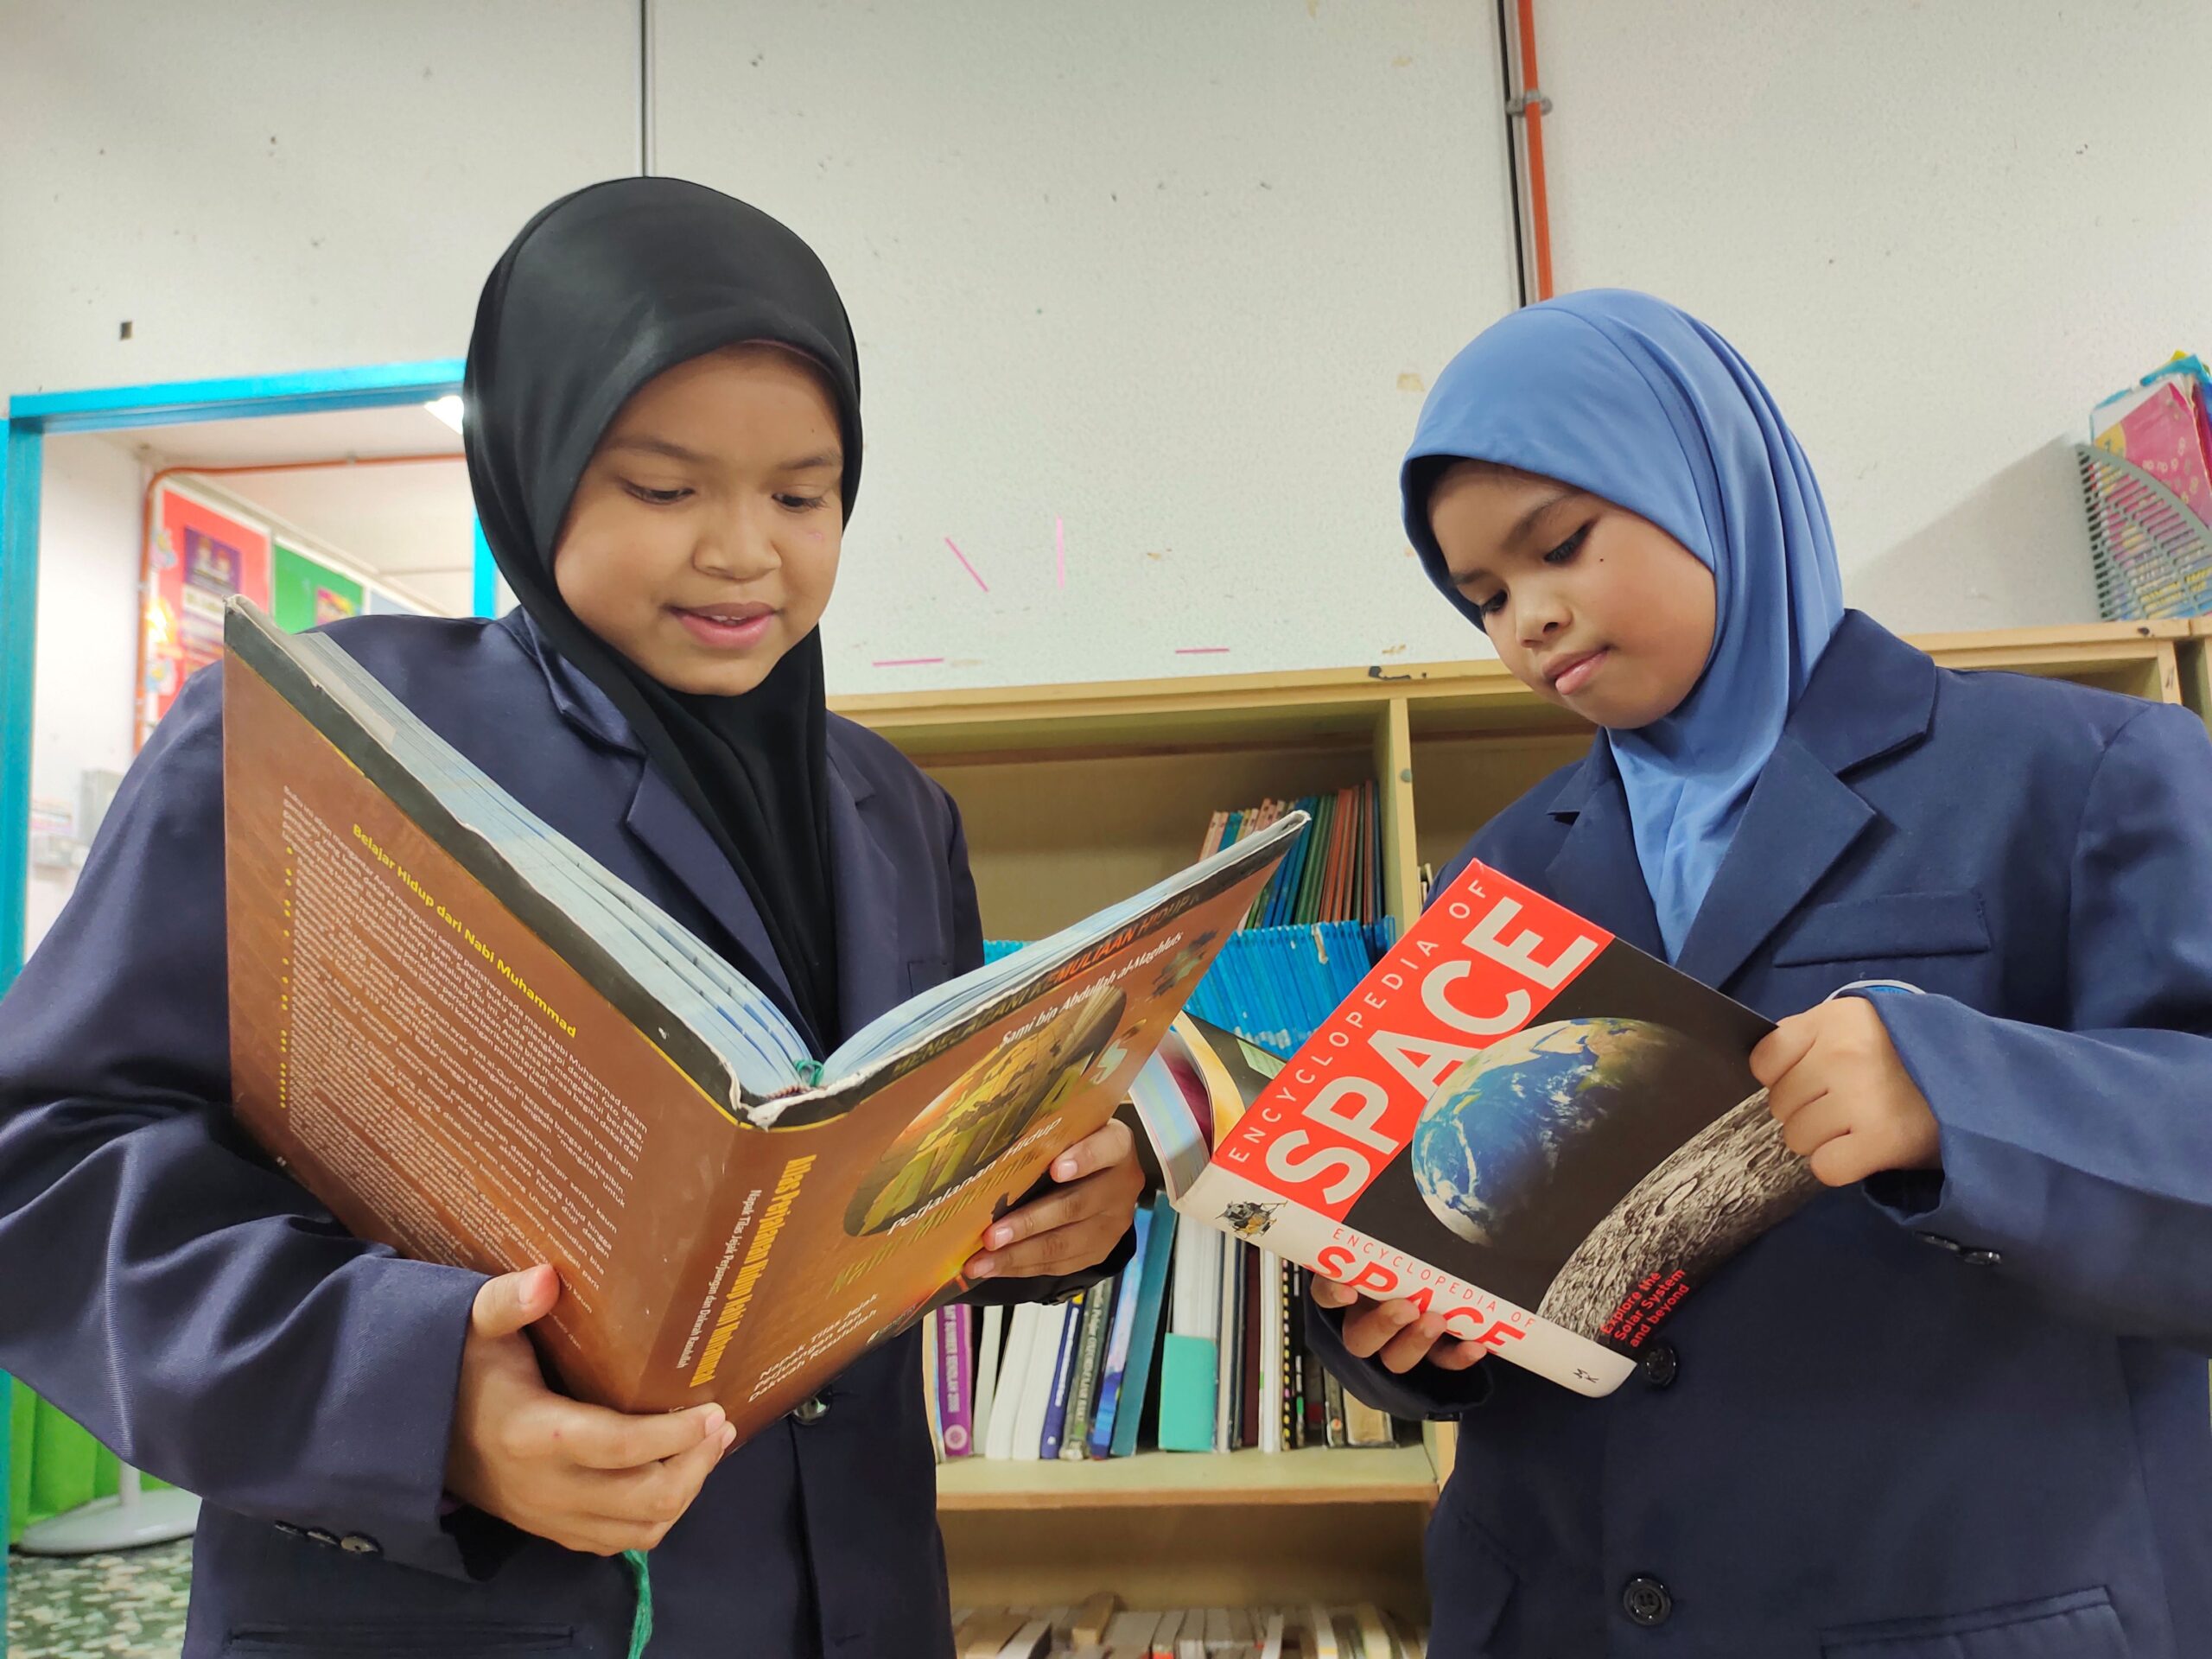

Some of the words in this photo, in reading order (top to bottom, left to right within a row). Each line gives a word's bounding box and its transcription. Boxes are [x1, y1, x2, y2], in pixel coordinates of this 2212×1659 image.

[353, 824, 395, 868] Belajar
[397, 867, 434, 906] Hidup
[437, 906, 461, 932] dari
[465, 930, 494, 963] Nabi
[498, 959, 575, 1038] Muhammad
[464, 959, 501, 996] peristiwa
[503, 995, 524, 1016] pada
[525, 1015, 546, 1038] masa
[549, 1035, 568, 1057] Nabi
[569, 1054, 620, 1106] Muhammad
[622, 1106, 646, 1134] dalam
[1000, 1015, 1036, 1048] Sami
[1036, 1005, 1058, 1027] bin
[1058, 970, 1116, 1013] Abdullah
[1229, 939, 1439, 1163] ENCYCLOPEDIA
[1449, 880, 1486, 918] OF
[1266, 896, 1598, 1205] SPACE
[465, 982, 484, 1004] buku
[503, 1019, 524, 1040] Anda
[528, 1041, 551, 1065] dapat
[555, 1065, 603, 1114] mengetahui
[607, 1113, 642, 1152] berbagai
[486, 990, 506, 1013] buku
[510, 1012, 520, 1025] ini
[523, 1025, 565, 1066] dilengkapi
[568, 1066, 598, 1098] dengan
[601, 1096, 620, 1119] foto,
[624, 1120, 643, 1143] peta,
[502, 1029, 523, 1051] Anda
[524, 1048, 541, 1067] bisa
[543, 1066, 572, 1096] merasa
[574, 1093, 599, 1122] begitu
[601, 1121, 622, 1146] dekat
[624, 1144, 638, 1161] dan
[494, 1045, 527, 1077] pemuda
[529, 1075, 563, 1111] berbagai
[565, 1109, 593, 1139] kabilah
[594, 1138, 613, 1161] yang
[614, 1157, 632, 1180] ingin
[521, 1101, 551, 1133] langkah
[603, 1182, 625, 1208] untuk
[525, 1094, 553, 1124] kepada
[555, 1122, 582, 1152] bangsa
[583, 1150, 594, 1163] Jin
[595, 1161, 624, 1196] Nasibin.
[858, 1039, 1128, 1236] ATLAS
[537, 1169, 563, 1199] Perang
[565, 1198, 586, 1222] Uhud
[588, 1221, 612, 1249] hingga
[541, 1151, 568, 1180] hampir
[570, 1182, 594, 1208] seribu
[596, 1208, 616, 1233] kaum
[741, 1190, 762, 1215] Napak
[887, 1160, 996, 1236] Perjalanan
[1002, 1117, 1062, 1162] Hidup
[582, 1228, 608, 1258] dengan
[590, 1256, 603, 1274] bisa
[725, 1236, 743, 1255] Jejak
[734, 1216, 751, 1235] Tilas
[743, 1189, 801, 1265] Perjalanan
[704, 1295, 717, 1309] dan
[709, 1254, 734, 1296] Perjuangan
[1317, 1245, 1527, 1354] SPACE
[1332, 1227, 1497, 1313] ENCYCLOPEDIA
[1510, 1311, 1536, 1329] OF
[1600, 1291, 1642, 1334] Explore
[1638, 1272, 1662, 1291] the
[1614, 1310, 1643, 1340] Solar
[1641, 1269, 1686, 1309] System
[1630, 1324, 1651, 1347] and
[1646, 1283, 1690, 1324] beyond
[691, 1308, 711, 1337] Dakwah
[748, 1360, 806, 1403] Dakwah
[810, 1309, 878, 1361] Rasulullah
[753, 1333, 834, 1392] Perjuangan
[837, 1312, 862, 1334] dan
[760, 1344, 806, 1380] Napak
[810, 1319, 842, 1344] Tilas
[843, 1293, 879, 1321] Jejak
